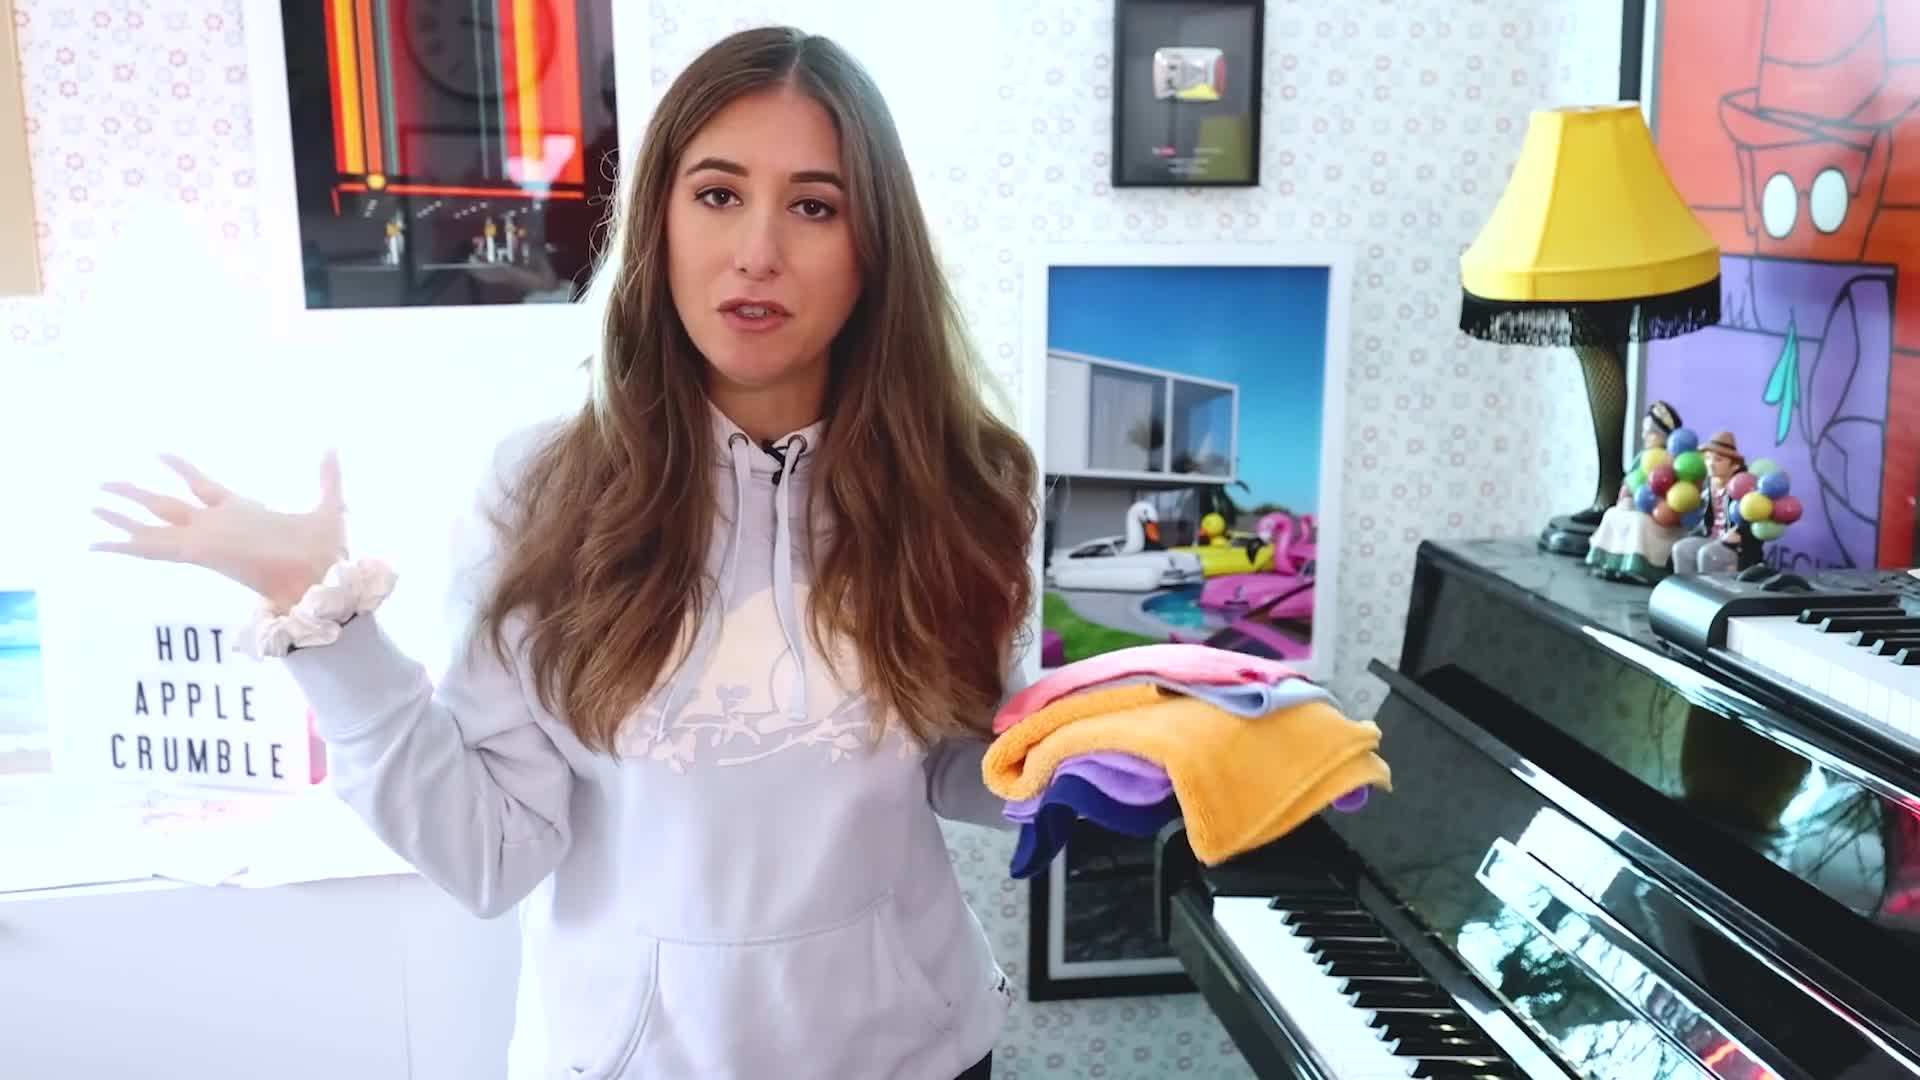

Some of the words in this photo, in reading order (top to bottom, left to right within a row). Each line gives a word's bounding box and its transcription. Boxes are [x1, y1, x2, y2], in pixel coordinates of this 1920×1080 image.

[156, 626, 223, 664] HOT
[136, 680, 255, 722] APPLE
[111, 733, 284, 779] CRUMBLE
